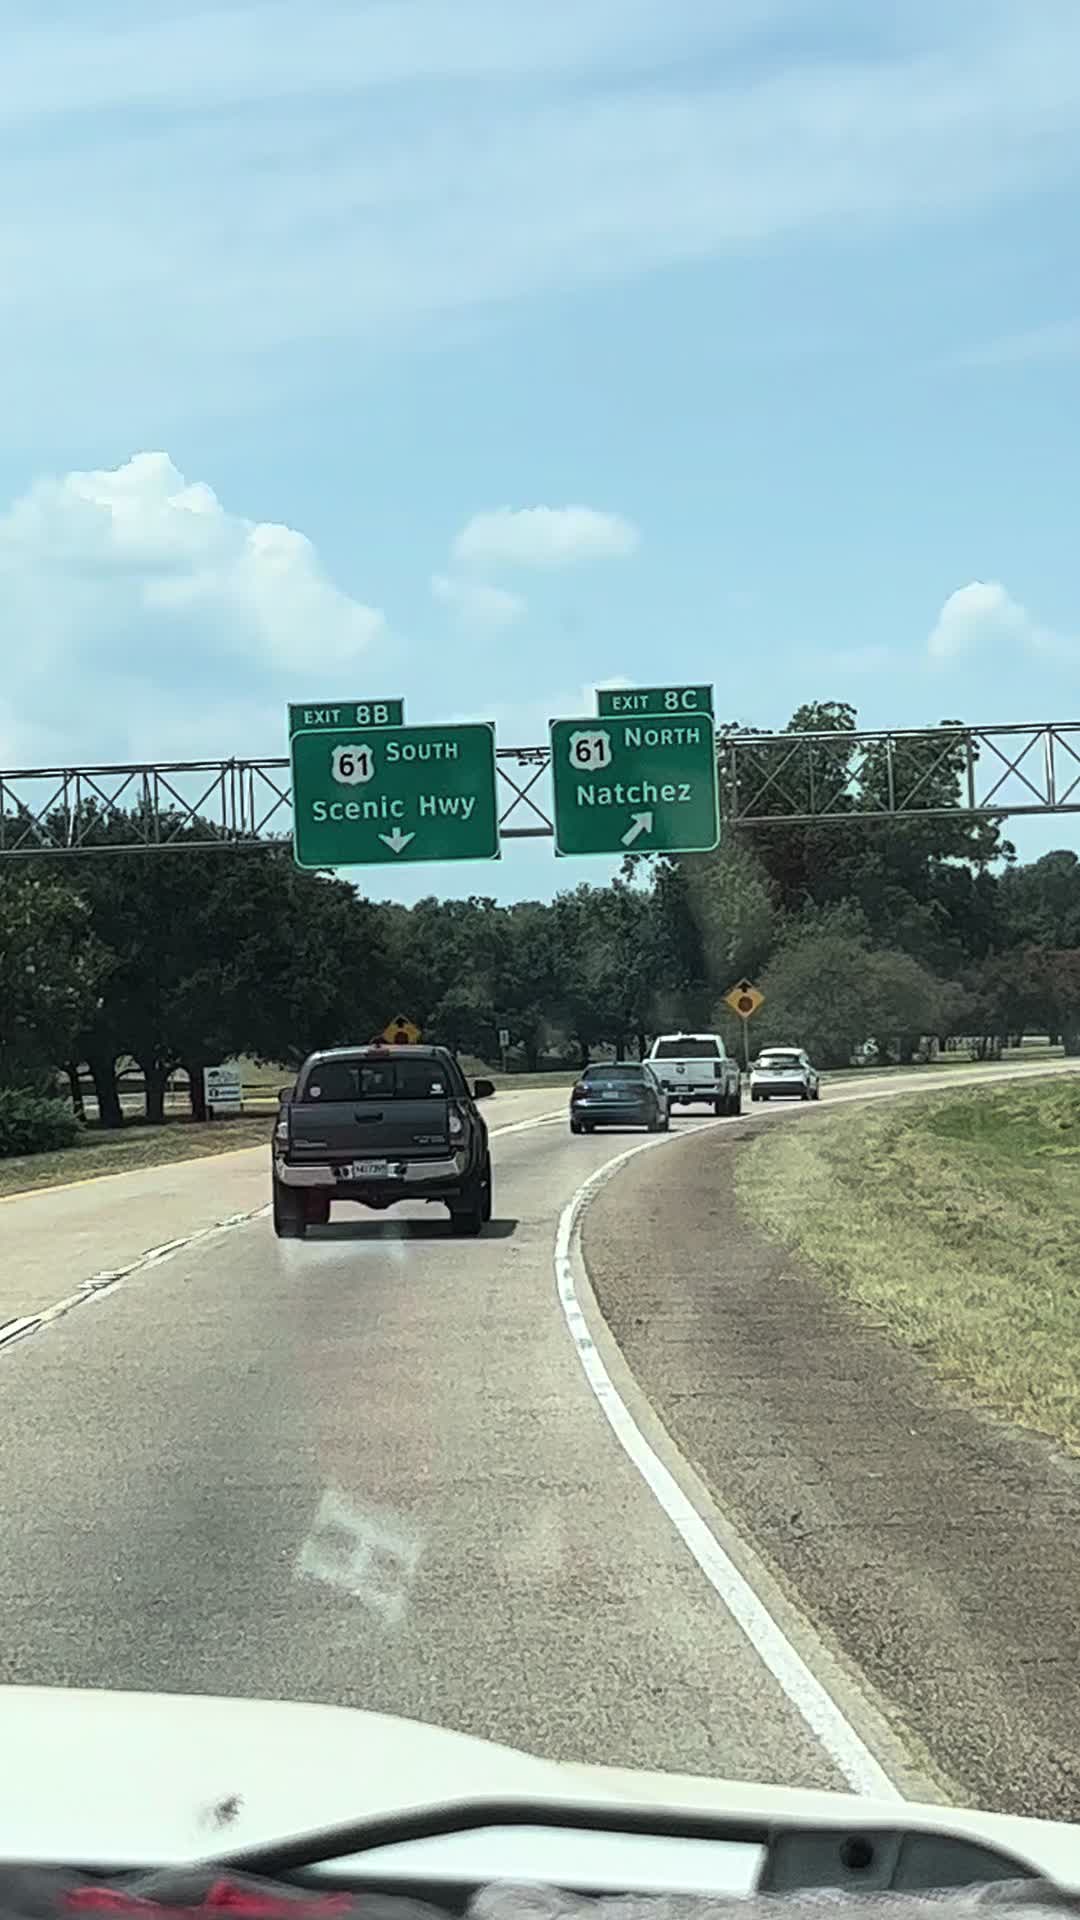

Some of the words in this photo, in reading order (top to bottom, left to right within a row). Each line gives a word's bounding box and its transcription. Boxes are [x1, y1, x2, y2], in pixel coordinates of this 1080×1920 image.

[612, 695, 649, 710] EXIT
[664, 690, 698, 710] 8C
[303, 709, 340, 724] EXIT
[356, 704, 389, 724] 8B
[575, 739, 605, 763] 61
[624, 727, 700, 746] NORTH
[339, 752, 368, 776] 61
[386, 742, 458, 761] SOUTH
[576, 781, 692, 806] Natchez
[312, 795, 404, 822] Scenic
[419, 795, 476, 820] Hwy
